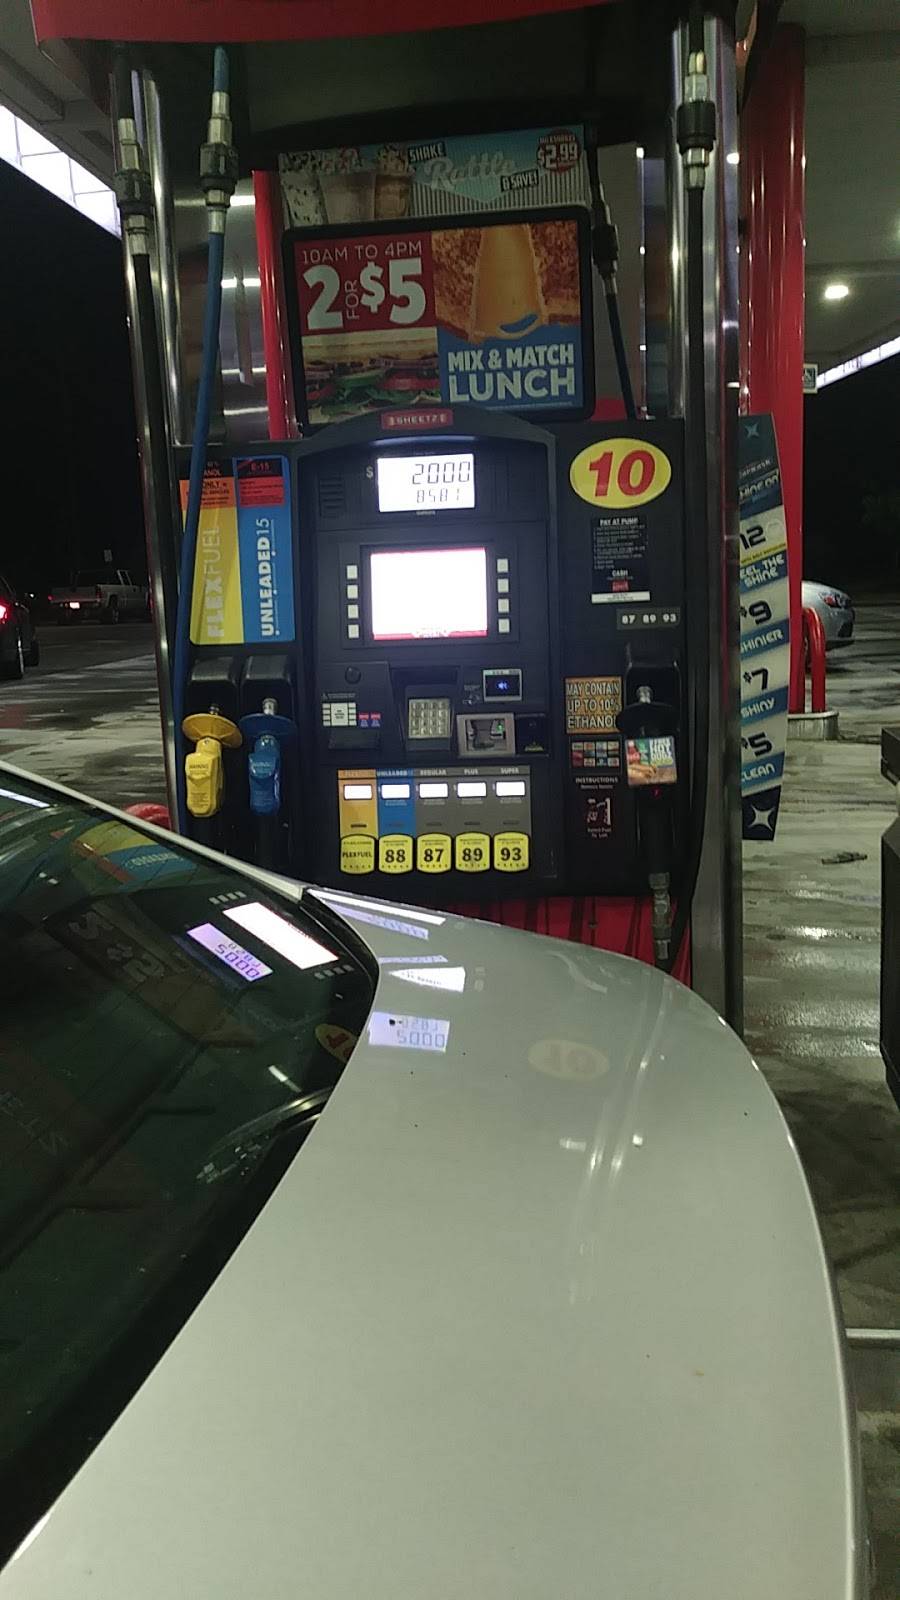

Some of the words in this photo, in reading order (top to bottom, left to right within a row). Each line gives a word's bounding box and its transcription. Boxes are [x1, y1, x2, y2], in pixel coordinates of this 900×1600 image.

[409, 143, 444, 162] SHAKE
[537, 142, 579, 169] $2.99
[424, 151, 517, 190] Rattle
[511, 170, 538, 187] SAVE!
[303, 247, 348, 265] 10AM
[355, 244, 378, 260] TO
[385, 240, 422, 257] 4PM
[303, 264, 344, 330] 2
[344, 280, 360, 320] FOR
[360, 257, 426, 325] $5
[448, 349, 484, 372] MIX
[488, 349, 502, 370] &
[506, 343, 574, 368] MATCH
[449, 367, 576, 403] LUNCH
[366, 466, 374, 479] $
[589, 449, 656, 498] 10
[740, 525, 766, 550] 12
[612, 569, 628, 577] CASH
[739, 565, 760, 580] EEL
[744, 567, 779, 589] SHINE
[622, 614, 636, 624] 87
[643, 614, 656, 624] 89
[663, 613, 676, 623] 93
[743, 667, 769, 691] $7
[566, 684, 583, 696] MAY
[584, 681, 620, 696] CONTAIN
[567, 699, 581, 713] UP
[583, 699, 597, 712] TO
[463, 768, 479, 776] PLUS
[500, 767, 519, 775] SUPER
[385, 848, 406, 864] 88
[423, 848, 445, 863] 87
[462, 847, 484, 862] 89
[500, 847, 522, 861] 93
